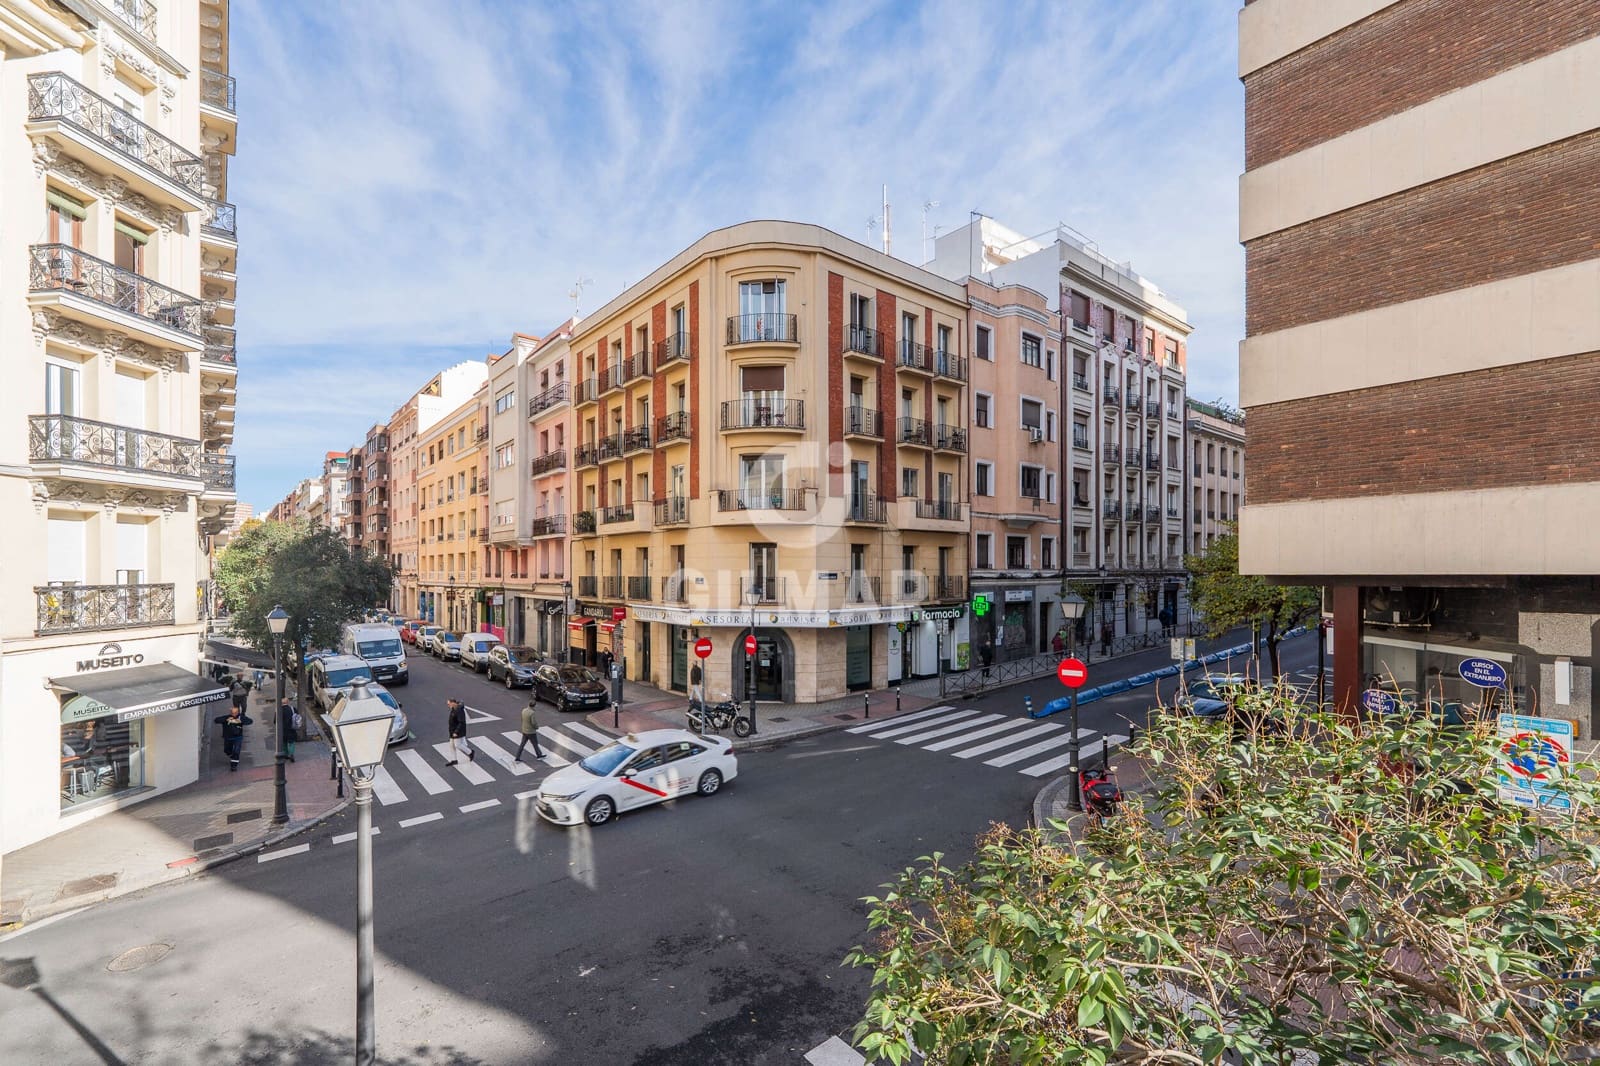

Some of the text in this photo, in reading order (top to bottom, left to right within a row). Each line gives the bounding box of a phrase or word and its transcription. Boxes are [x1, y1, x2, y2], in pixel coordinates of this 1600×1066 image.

[781, 614, 821, 625] adviser
[921, 608, 961, 621] Farmacia
[76, 653, 144, 673] MUSEITO
[1471, 661, 1494, 670] CURSOS
[1463, 670, 1502, 682] EXTRANJERO
[73, 704, 110, 716] MUSEITO
[124, 703, 178, 720] EMPANADAS
[180, 692, 226, 708] ARGENTINAS
